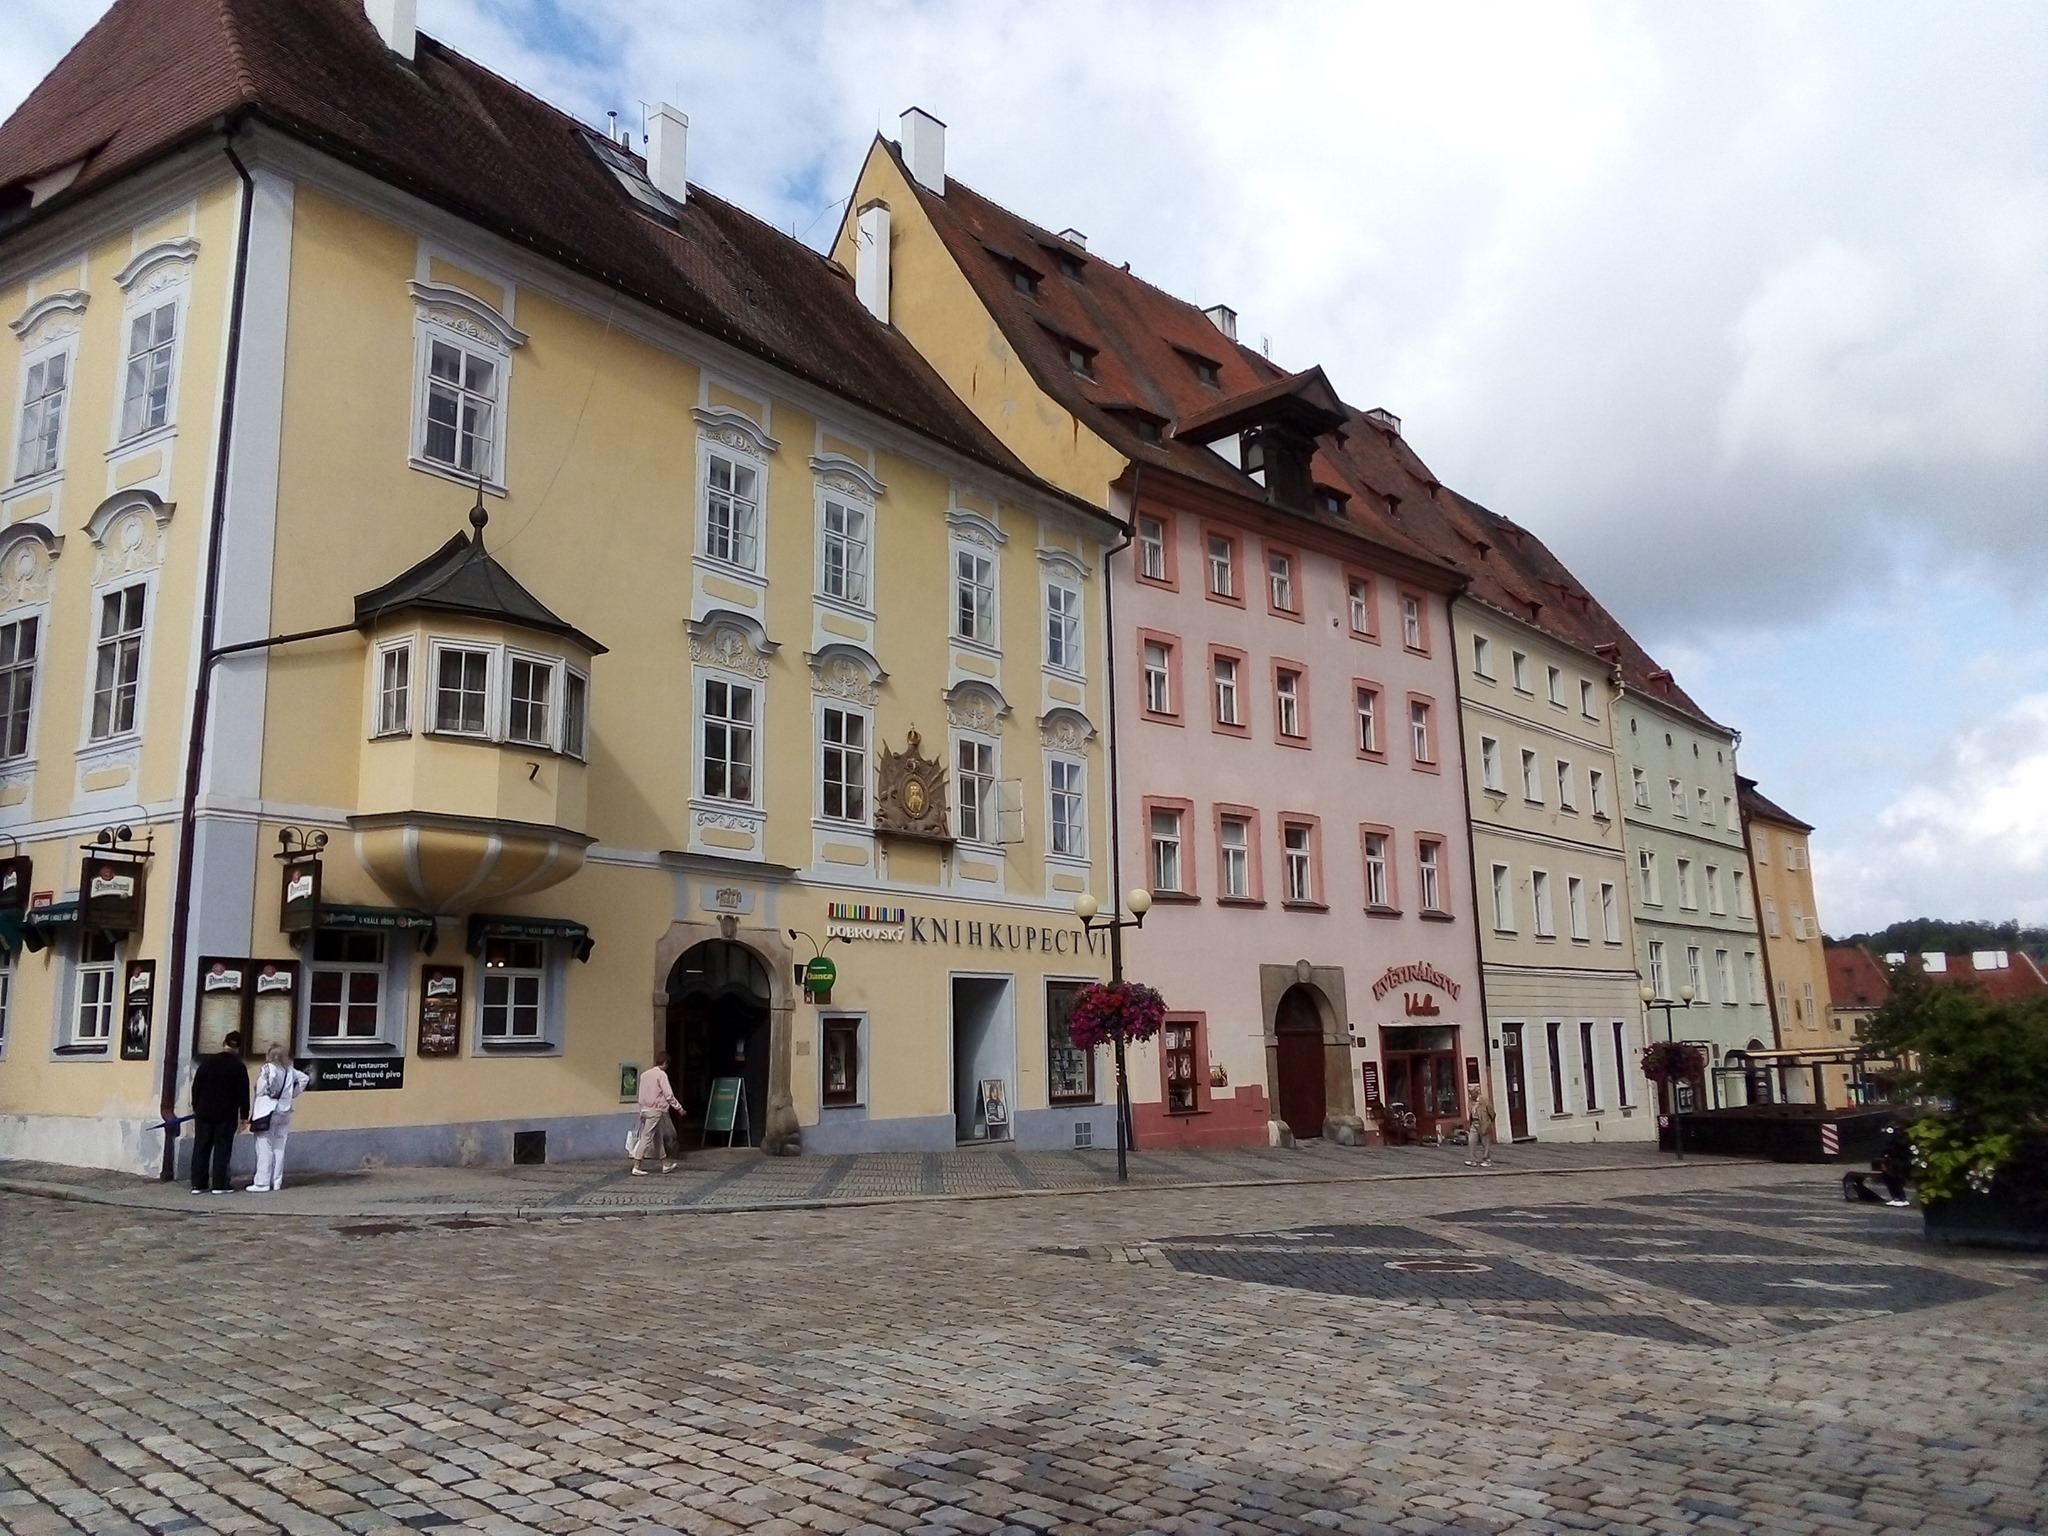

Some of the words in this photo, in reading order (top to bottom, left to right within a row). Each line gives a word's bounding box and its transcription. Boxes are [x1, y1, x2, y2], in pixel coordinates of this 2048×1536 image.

[826, 925, 905, 941] DOBROVSKÝ
[322, 1071, 353, 1080] čepujeme
[355, 1070, 384, 1079] tankové
[386, 1070, 401, 1079] pivo
